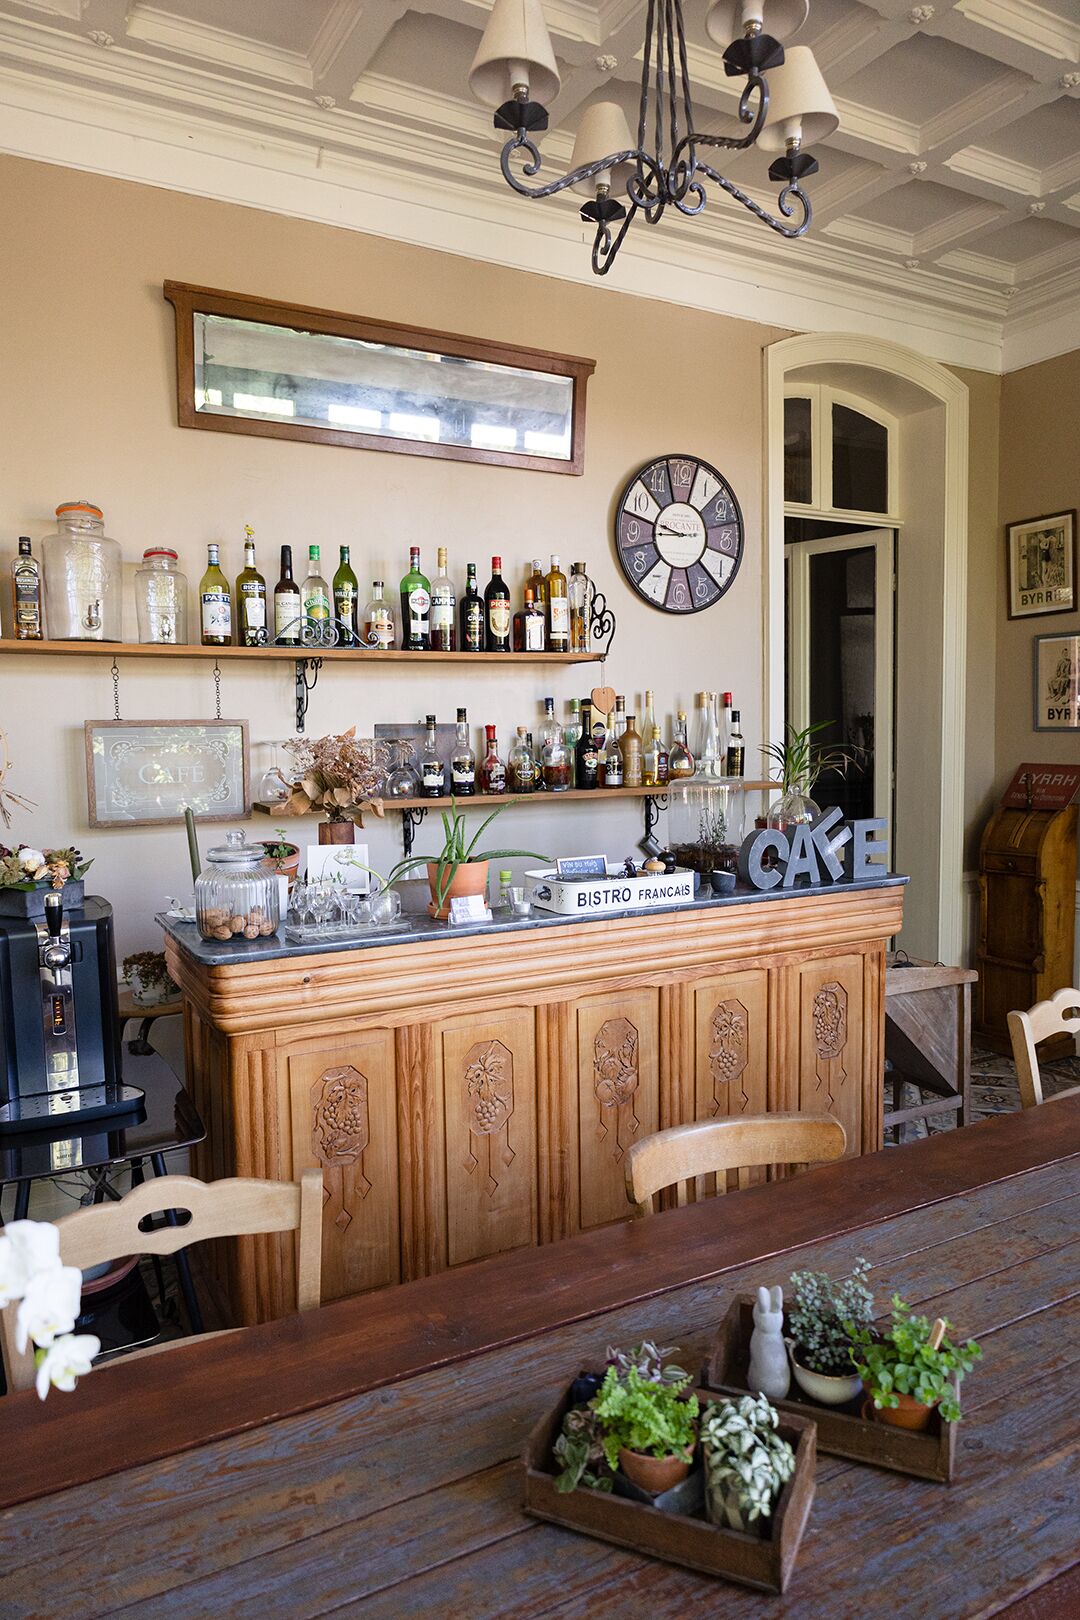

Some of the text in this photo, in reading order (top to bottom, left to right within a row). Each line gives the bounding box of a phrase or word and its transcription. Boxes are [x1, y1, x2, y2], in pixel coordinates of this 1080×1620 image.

[650, 469, 665, 493] 11
[673, 463, 693, 488] 12
[634, 491, 650, 513] 10
[715, 498, 728, 521] 2
[626, 520, 641, 543] 9
[720, 528, 734, 551] 3
[633, 551, 648, 573] 8
[672, 582, 687, 604] 6
[695, 576, 708, 598] 5
[138, 762, 206, 784] CAFÉ
[739, 806, 888, 890] CAFE
[577, 887, 632, 907] BISTRO
